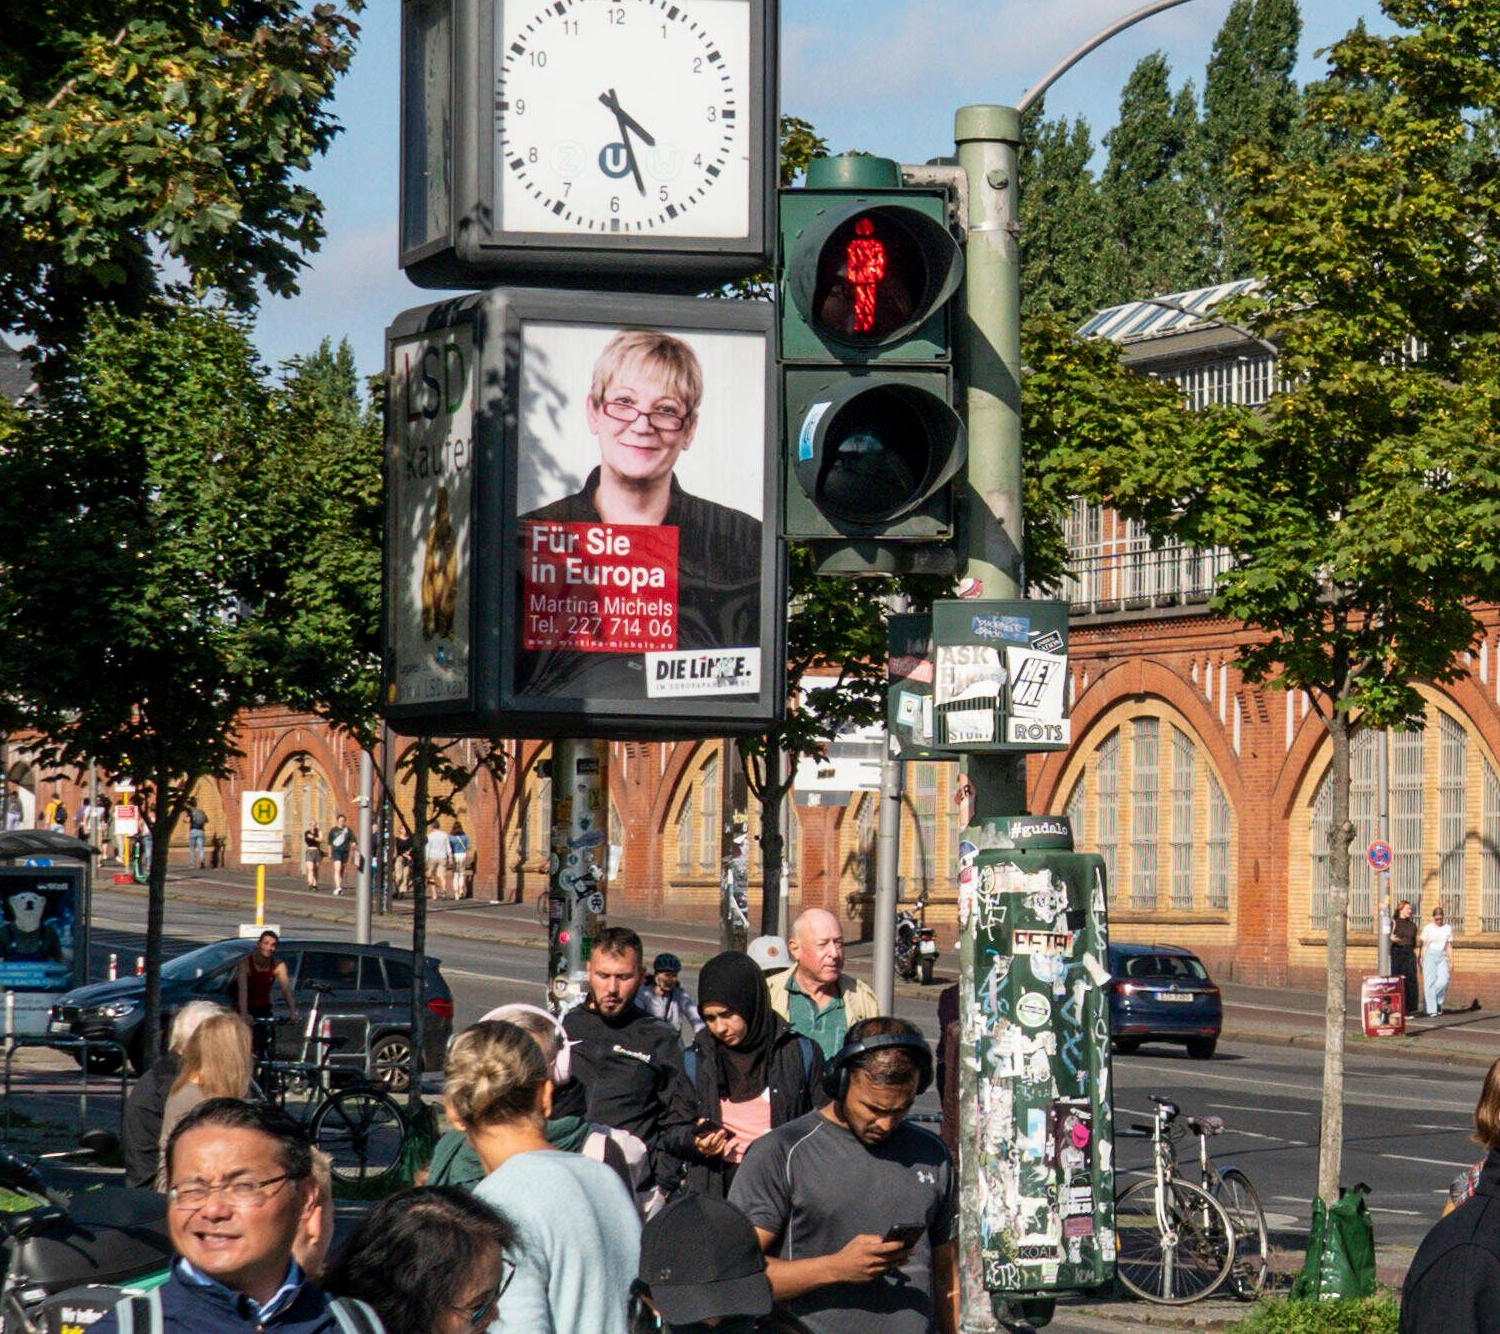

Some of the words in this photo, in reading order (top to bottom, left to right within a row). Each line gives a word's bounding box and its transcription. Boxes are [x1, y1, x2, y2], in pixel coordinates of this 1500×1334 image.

[608, 8, 626, 25] 12
[563, 20, 579, 36] 11
[661, 24, 668, 39] 1
[529, 51, 547, 67] 10
[693, 57, 703, 74] 2
[515, 99, 526, 115] 9
[707, 106, 717, 123] 3
[529, 147, 538, 163] 8
[693, 153, 703, 167] 4
[563, 182, 572, 198] 7
[659, 185, 669, 202] 5
[610, 196, 620, 213] 6
[531, 525, 580, 554] Für
[586, 527, 631, 556] Sie
[530, 556, 556, 584] in
[565, 557, 666, 594] Europa
[529, 594, 600, 615] Martina
[603, 596, 673, 617] Michels
[529, 614, 560, 634] Tel.
[567, 616, 601, 635] 227
[610, 617, 642, 637] 714
[648, 618, 673, 638] 06
[941, 646, 990, 665] ASK
[656, 659, 687, 681] DIE
[1014, 724, 1064, 741] ROTS
